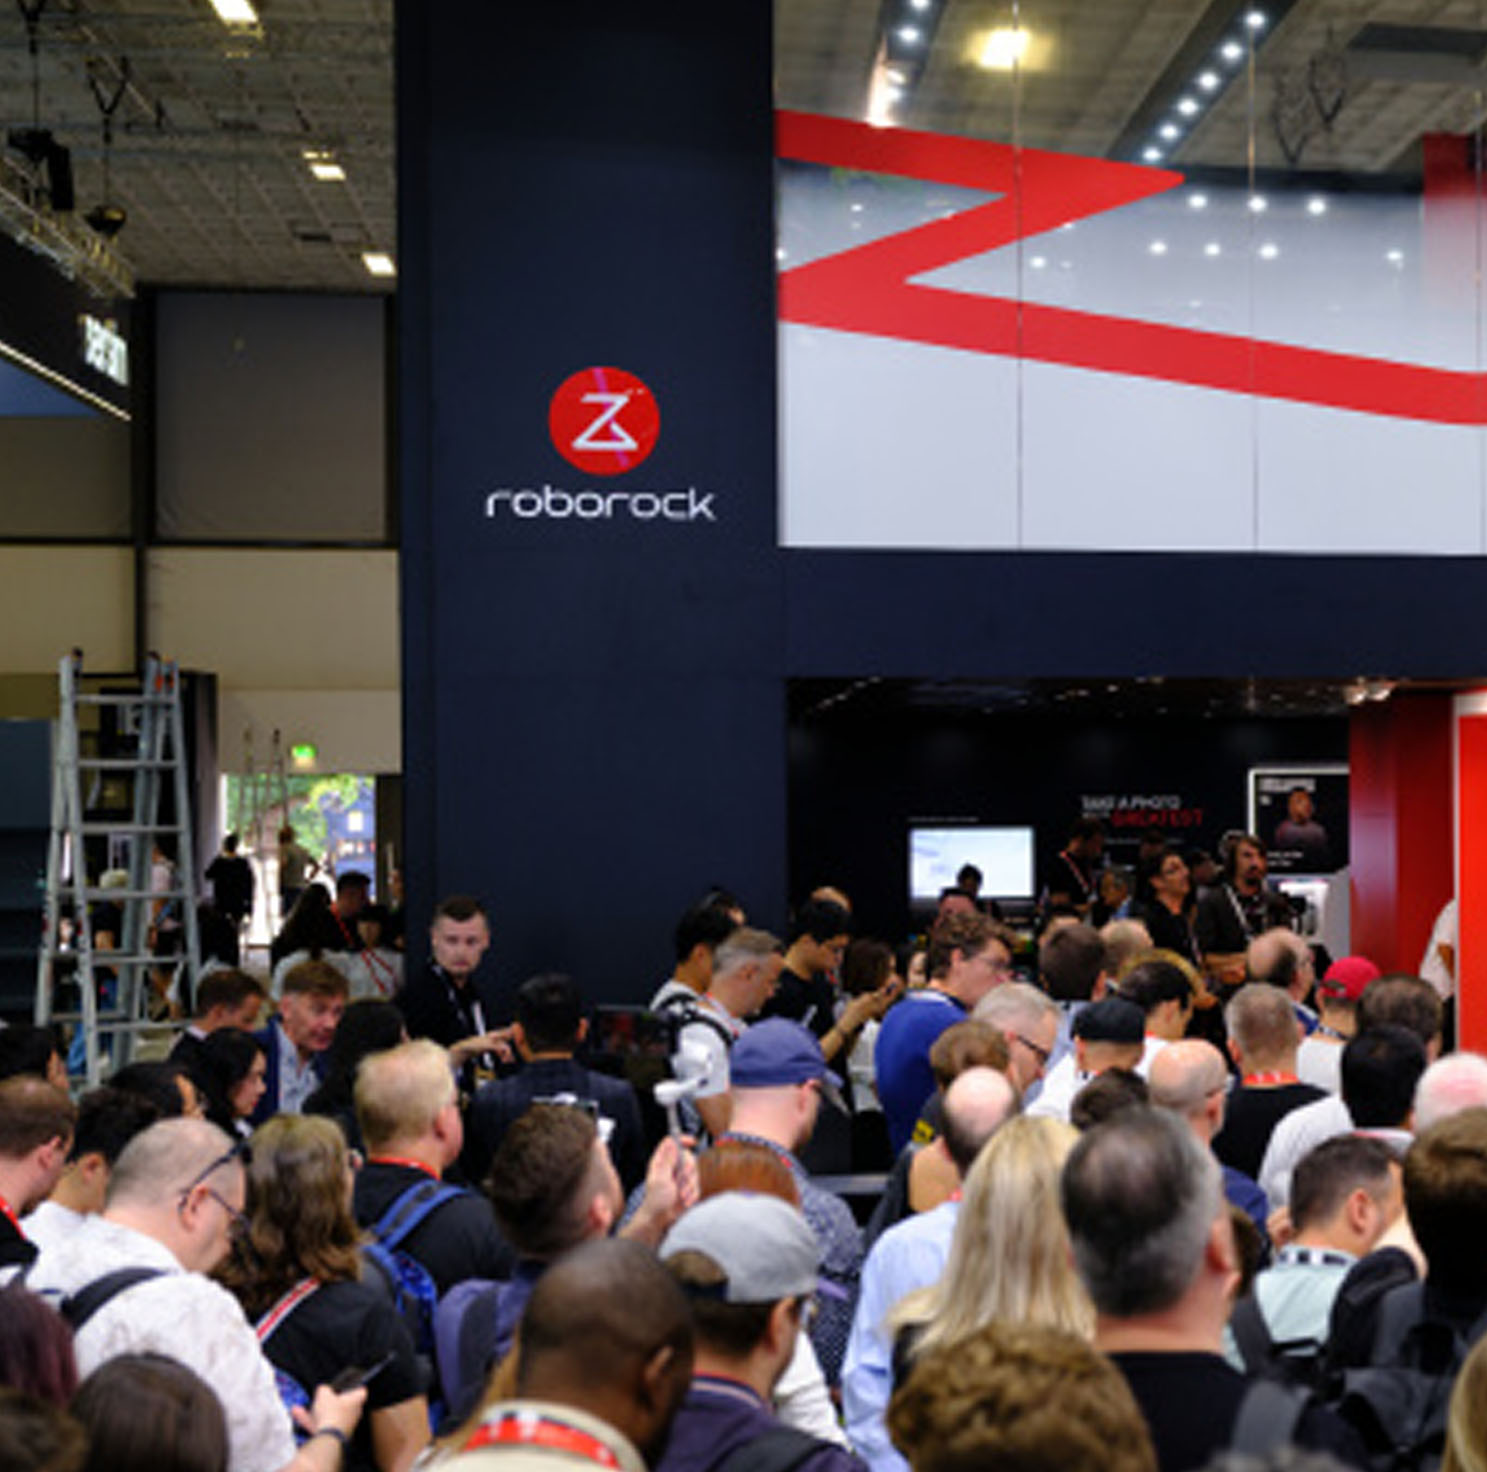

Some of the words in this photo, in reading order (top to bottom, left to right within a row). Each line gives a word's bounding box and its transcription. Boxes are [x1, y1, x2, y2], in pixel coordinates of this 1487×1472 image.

[485, 484, 717, 520] roborock
[1081, 796, 1114, 809] TAKE
[1117, 796, 1128, 809] A
[1130, 796, 1181, 809] PHOTO
[1110, 809, 1203, 828] GREATEST
